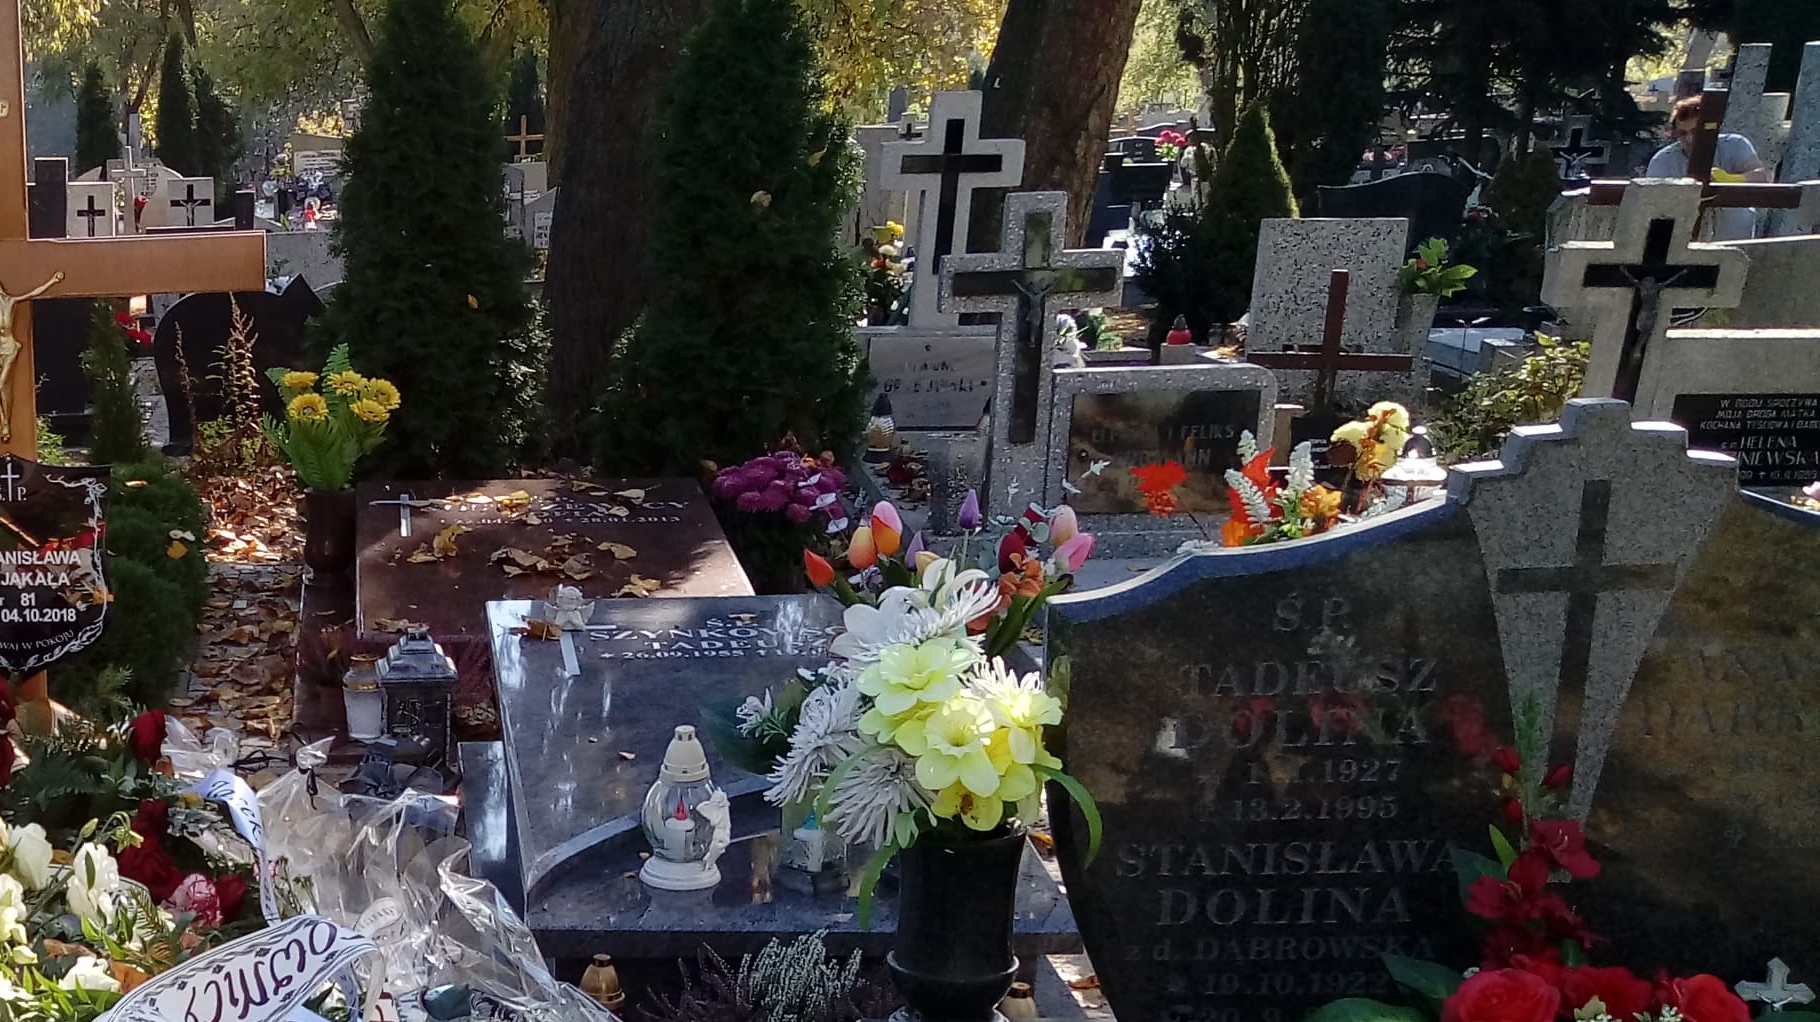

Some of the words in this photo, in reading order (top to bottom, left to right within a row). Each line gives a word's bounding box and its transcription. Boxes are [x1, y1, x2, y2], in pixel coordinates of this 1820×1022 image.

[1740, 435, 1797, 449] HELENA
[1736, 450, 1820, 465] NIEWSKA
[20, 593, 36, 606] 81
[0, 607, 77, 623] 04.10.2018
[35, 628, 75, 650] POKOJU
[1179, 656, 1438, 698] TADEUSZ
[1116, 838, 1460, 879] STANISŁAWA
[1155, 886, 1413, 927] DOLINA
